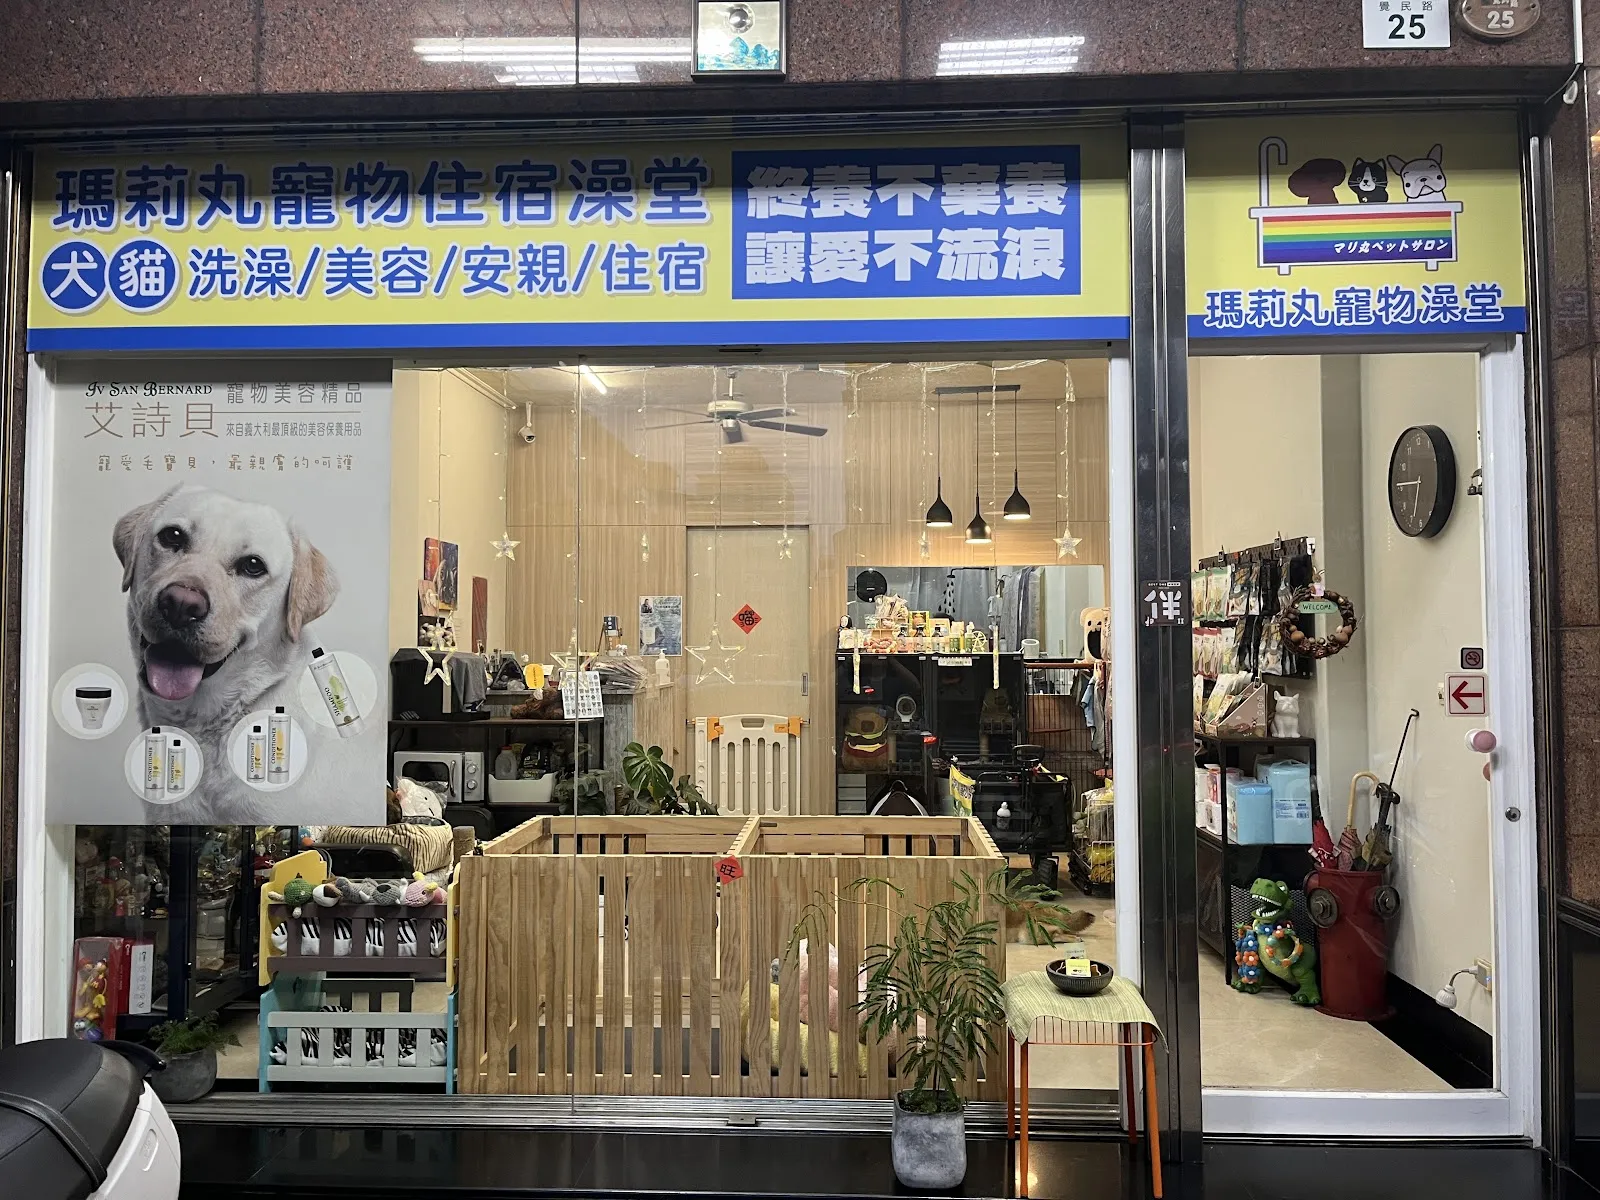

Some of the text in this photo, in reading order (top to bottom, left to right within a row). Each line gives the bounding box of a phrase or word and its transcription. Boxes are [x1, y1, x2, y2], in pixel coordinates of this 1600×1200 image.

[1388, 14, 1426, 40] 25
[1487, 10, 1515, 29] 25
[52, 156, 709, 229] 瑪莉丸寵物住宿澡堂
[746, 161, 1069, 219] 終養不棄養
[188, 242, 706, 297] 洗澡/美容/安親/住宿
[745, 226, 1067, 285] 讓愛不流浪
[1203, 282, 1504, 327] 瑪莉丸寵物澡堂
[226, 381, 362, 404] 寵物美容精品
[84, 401, 219, 438] 艾詩貝
[226, 422, 362, 437] 來自義大利最頂級的美容保養用品
[1143, 589, 1182, 620] 伴
[719, 863, 737, 879] 旺
